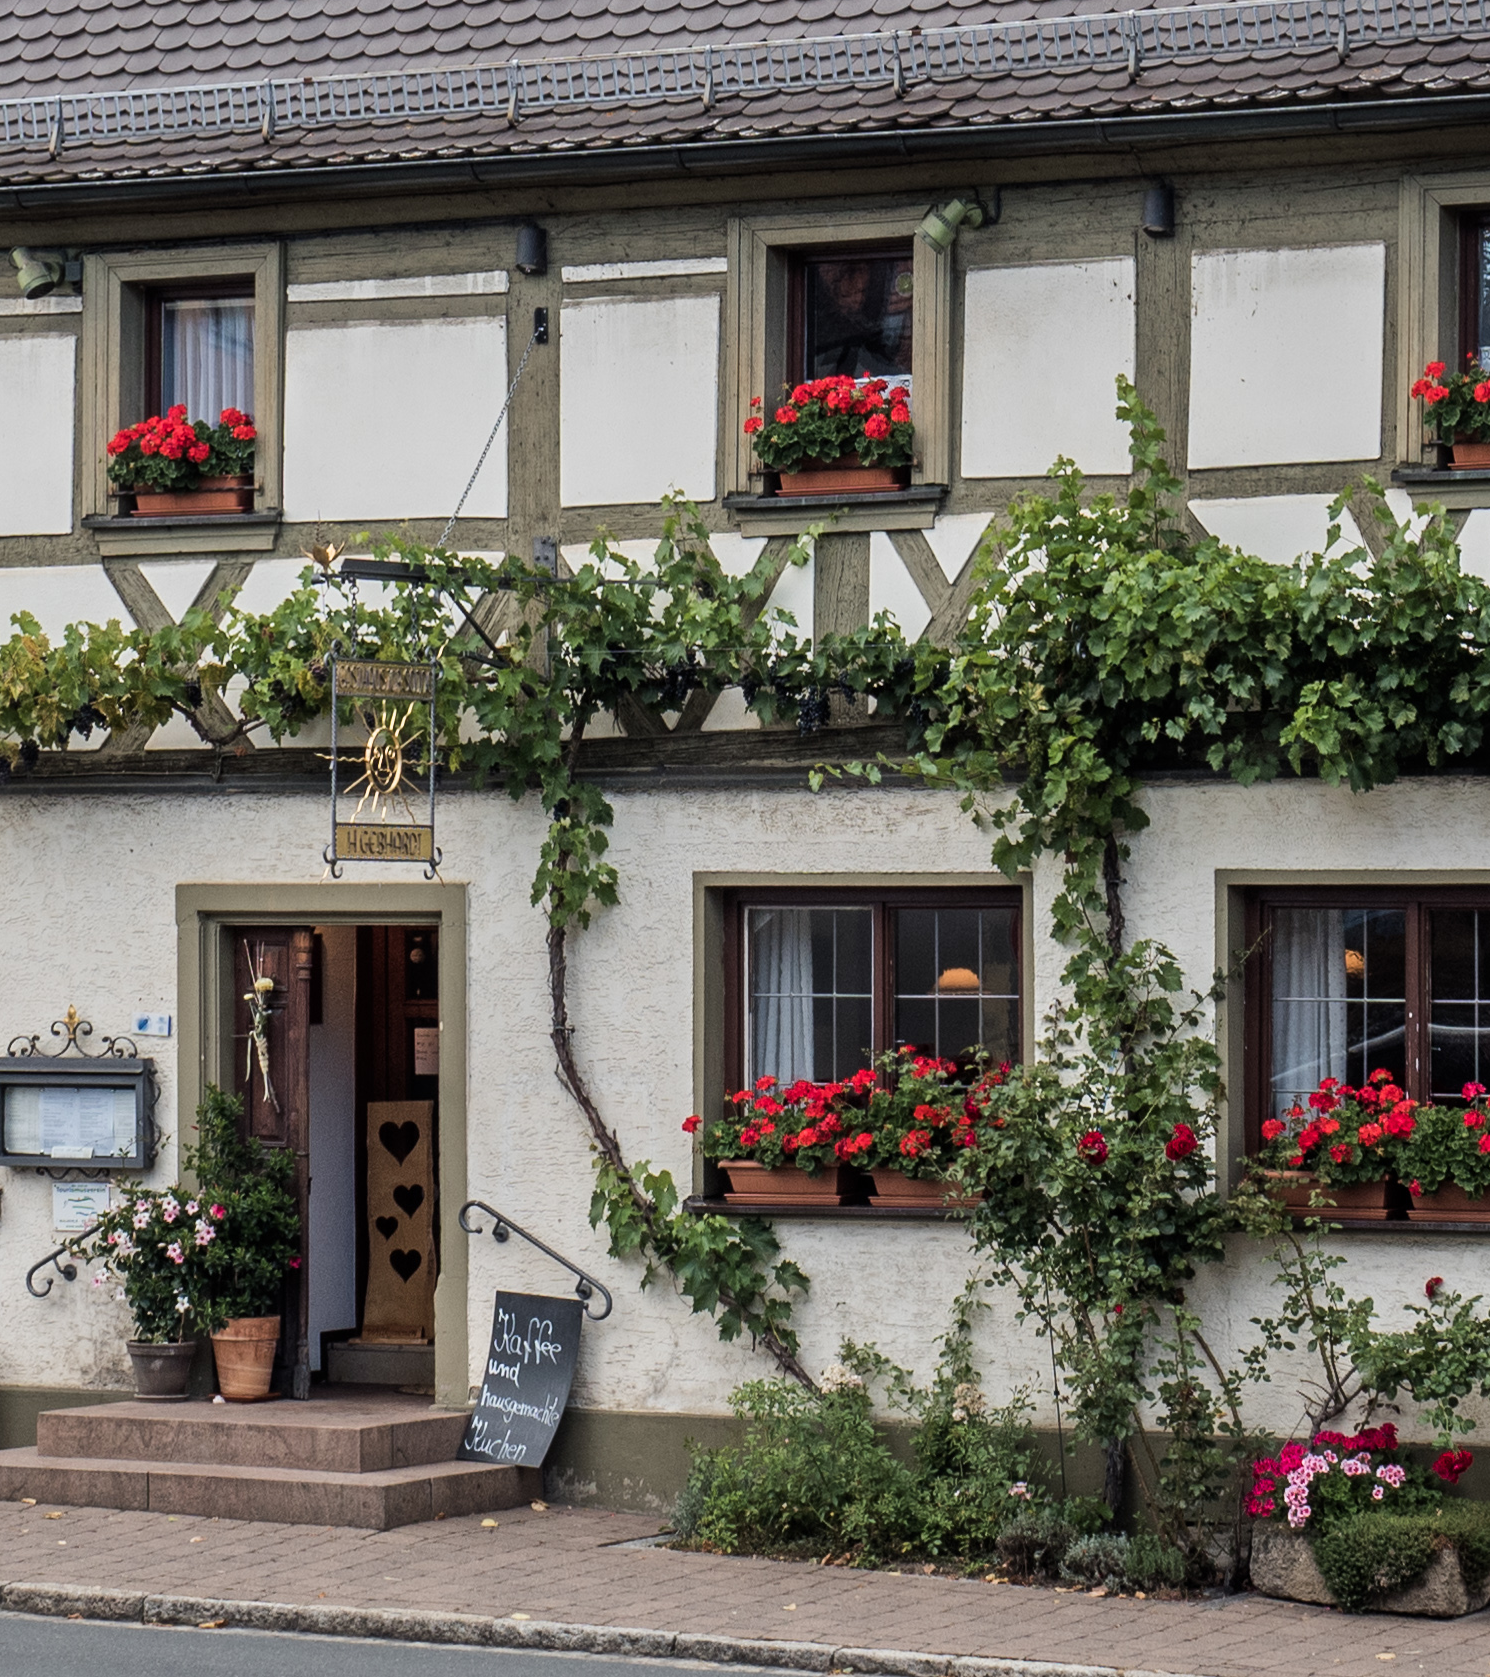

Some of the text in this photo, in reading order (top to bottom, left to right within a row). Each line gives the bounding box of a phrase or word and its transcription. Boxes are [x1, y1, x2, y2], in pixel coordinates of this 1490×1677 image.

[494, 1307, 562, 1365] Kaffee
[488, 1357, 521, 1388] und
[480, 1383, 560, 1428] hausgemachte
[464, 1415, 527, 1463] Kuchen
